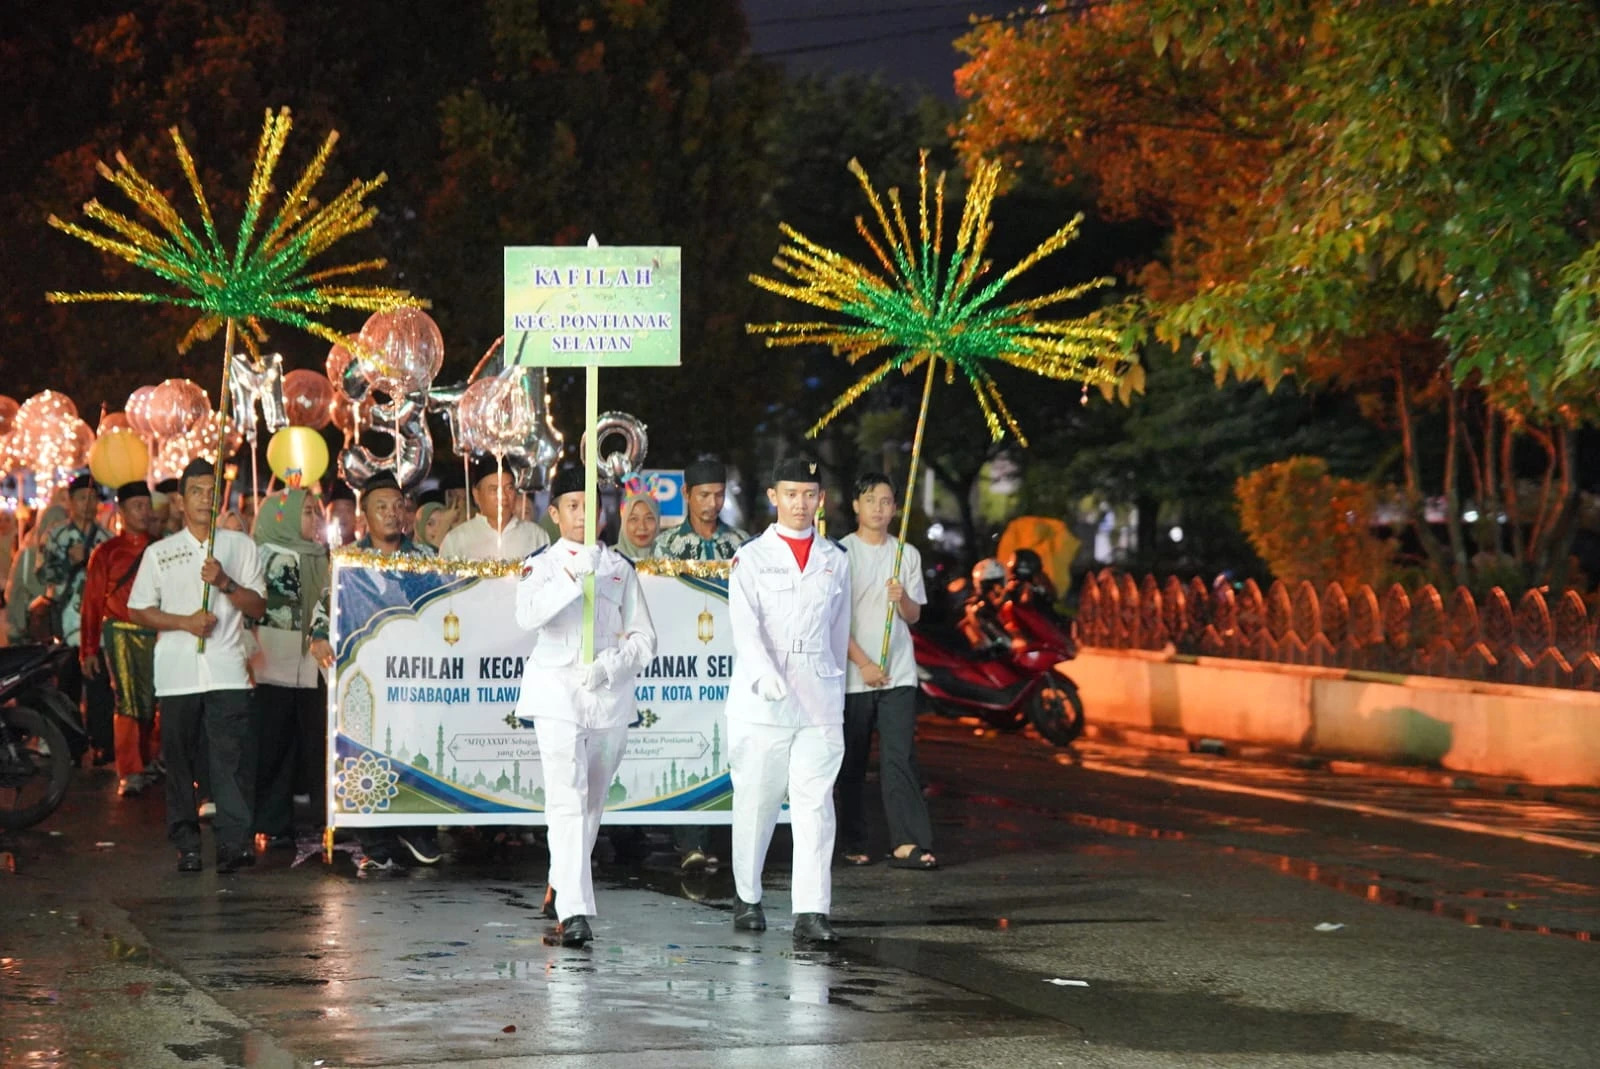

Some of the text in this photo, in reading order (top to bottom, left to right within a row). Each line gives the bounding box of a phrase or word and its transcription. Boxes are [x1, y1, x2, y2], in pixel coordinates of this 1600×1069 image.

[534, 268, 653, 286] KAFILAH
[514, 313, 672, 330] KEC. PONTIANAK
[552, 335, 632, 350] SELATAN
[386, 655, 465, 680] KAFILAH
[479, 655, 530, 680] KECA
[636, 655, 698, 678] IANAK
[387, 686, 470, 705] MUSABAQAH
[635, 685, 656, 701] KAT
[662, 685, 693, 701] KOTA
